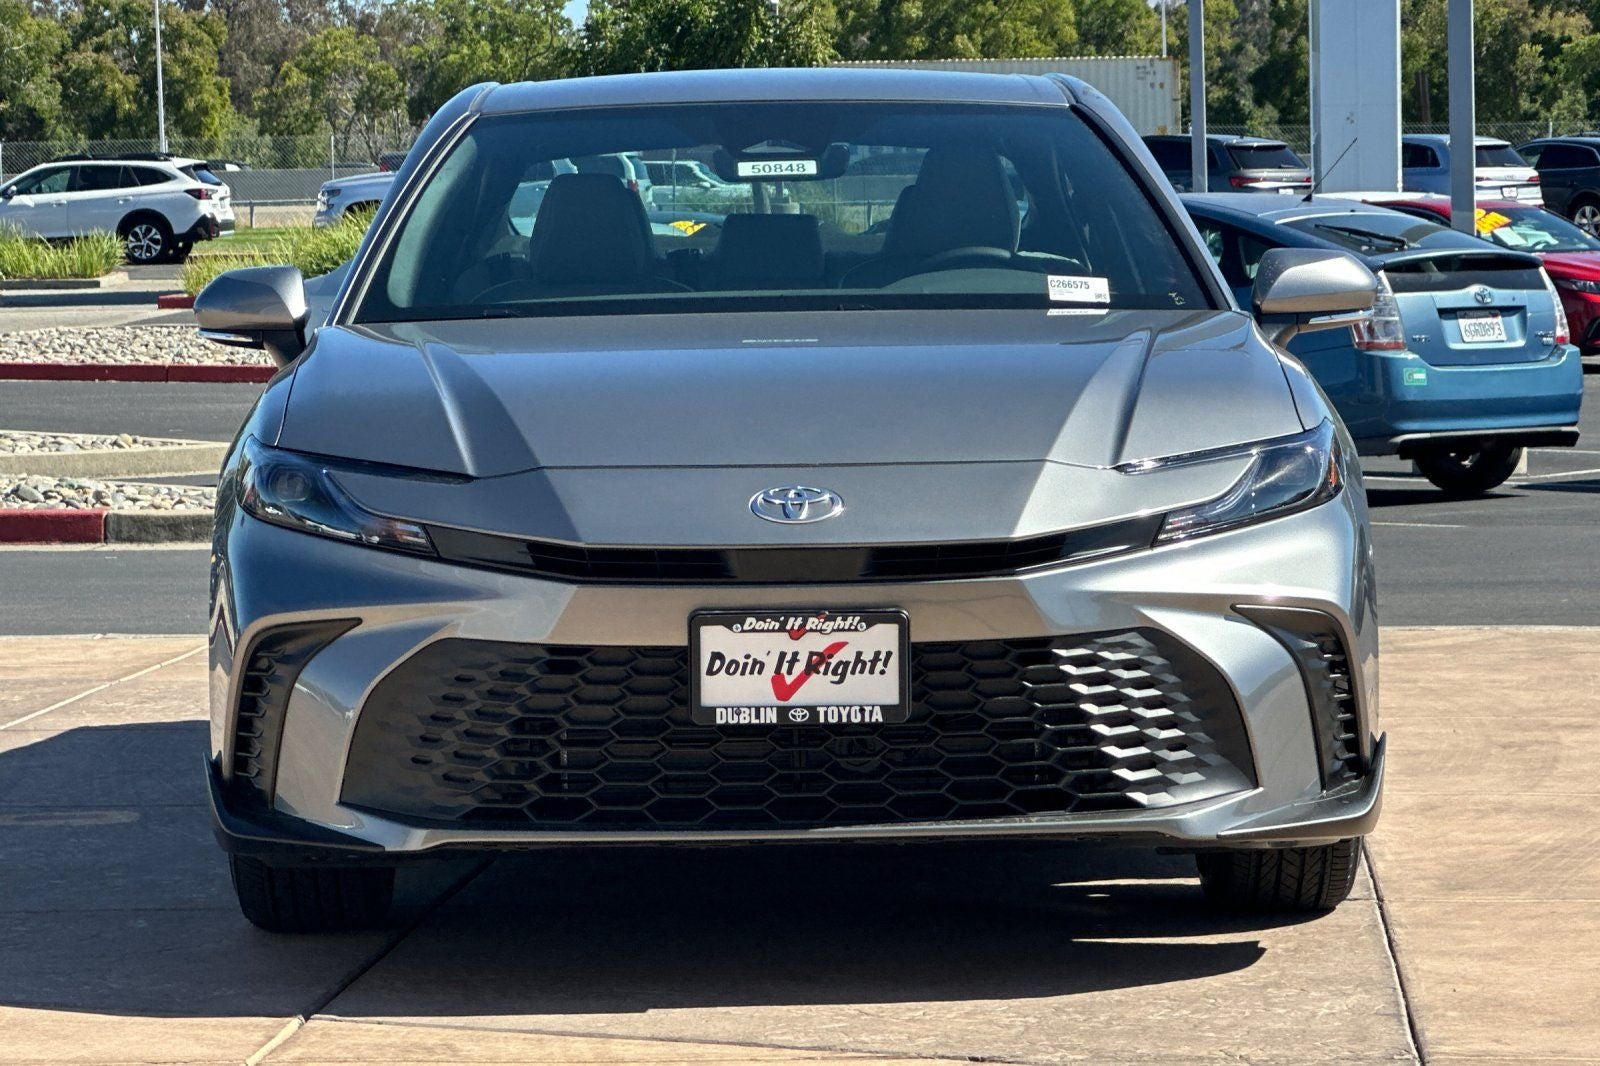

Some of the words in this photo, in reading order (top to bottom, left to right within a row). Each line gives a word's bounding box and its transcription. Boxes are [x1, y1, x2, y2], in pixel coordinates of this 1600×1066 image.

[751, 163, 806, 174] 50848
[1049, 279, 1090, 290] C266575
[743, 616, 784, 630] Doin'
[785, 616, 803, 630] It
[805, 616, 860, 635] Right!
[705, 650, 771, 676] Doin'
[773, 650, 801, 676] It
[804, 650, 893, 684] Right!
[715, 706, 777, 725] DUBLIN
[816, 705, 884, 723] TOYOTA
